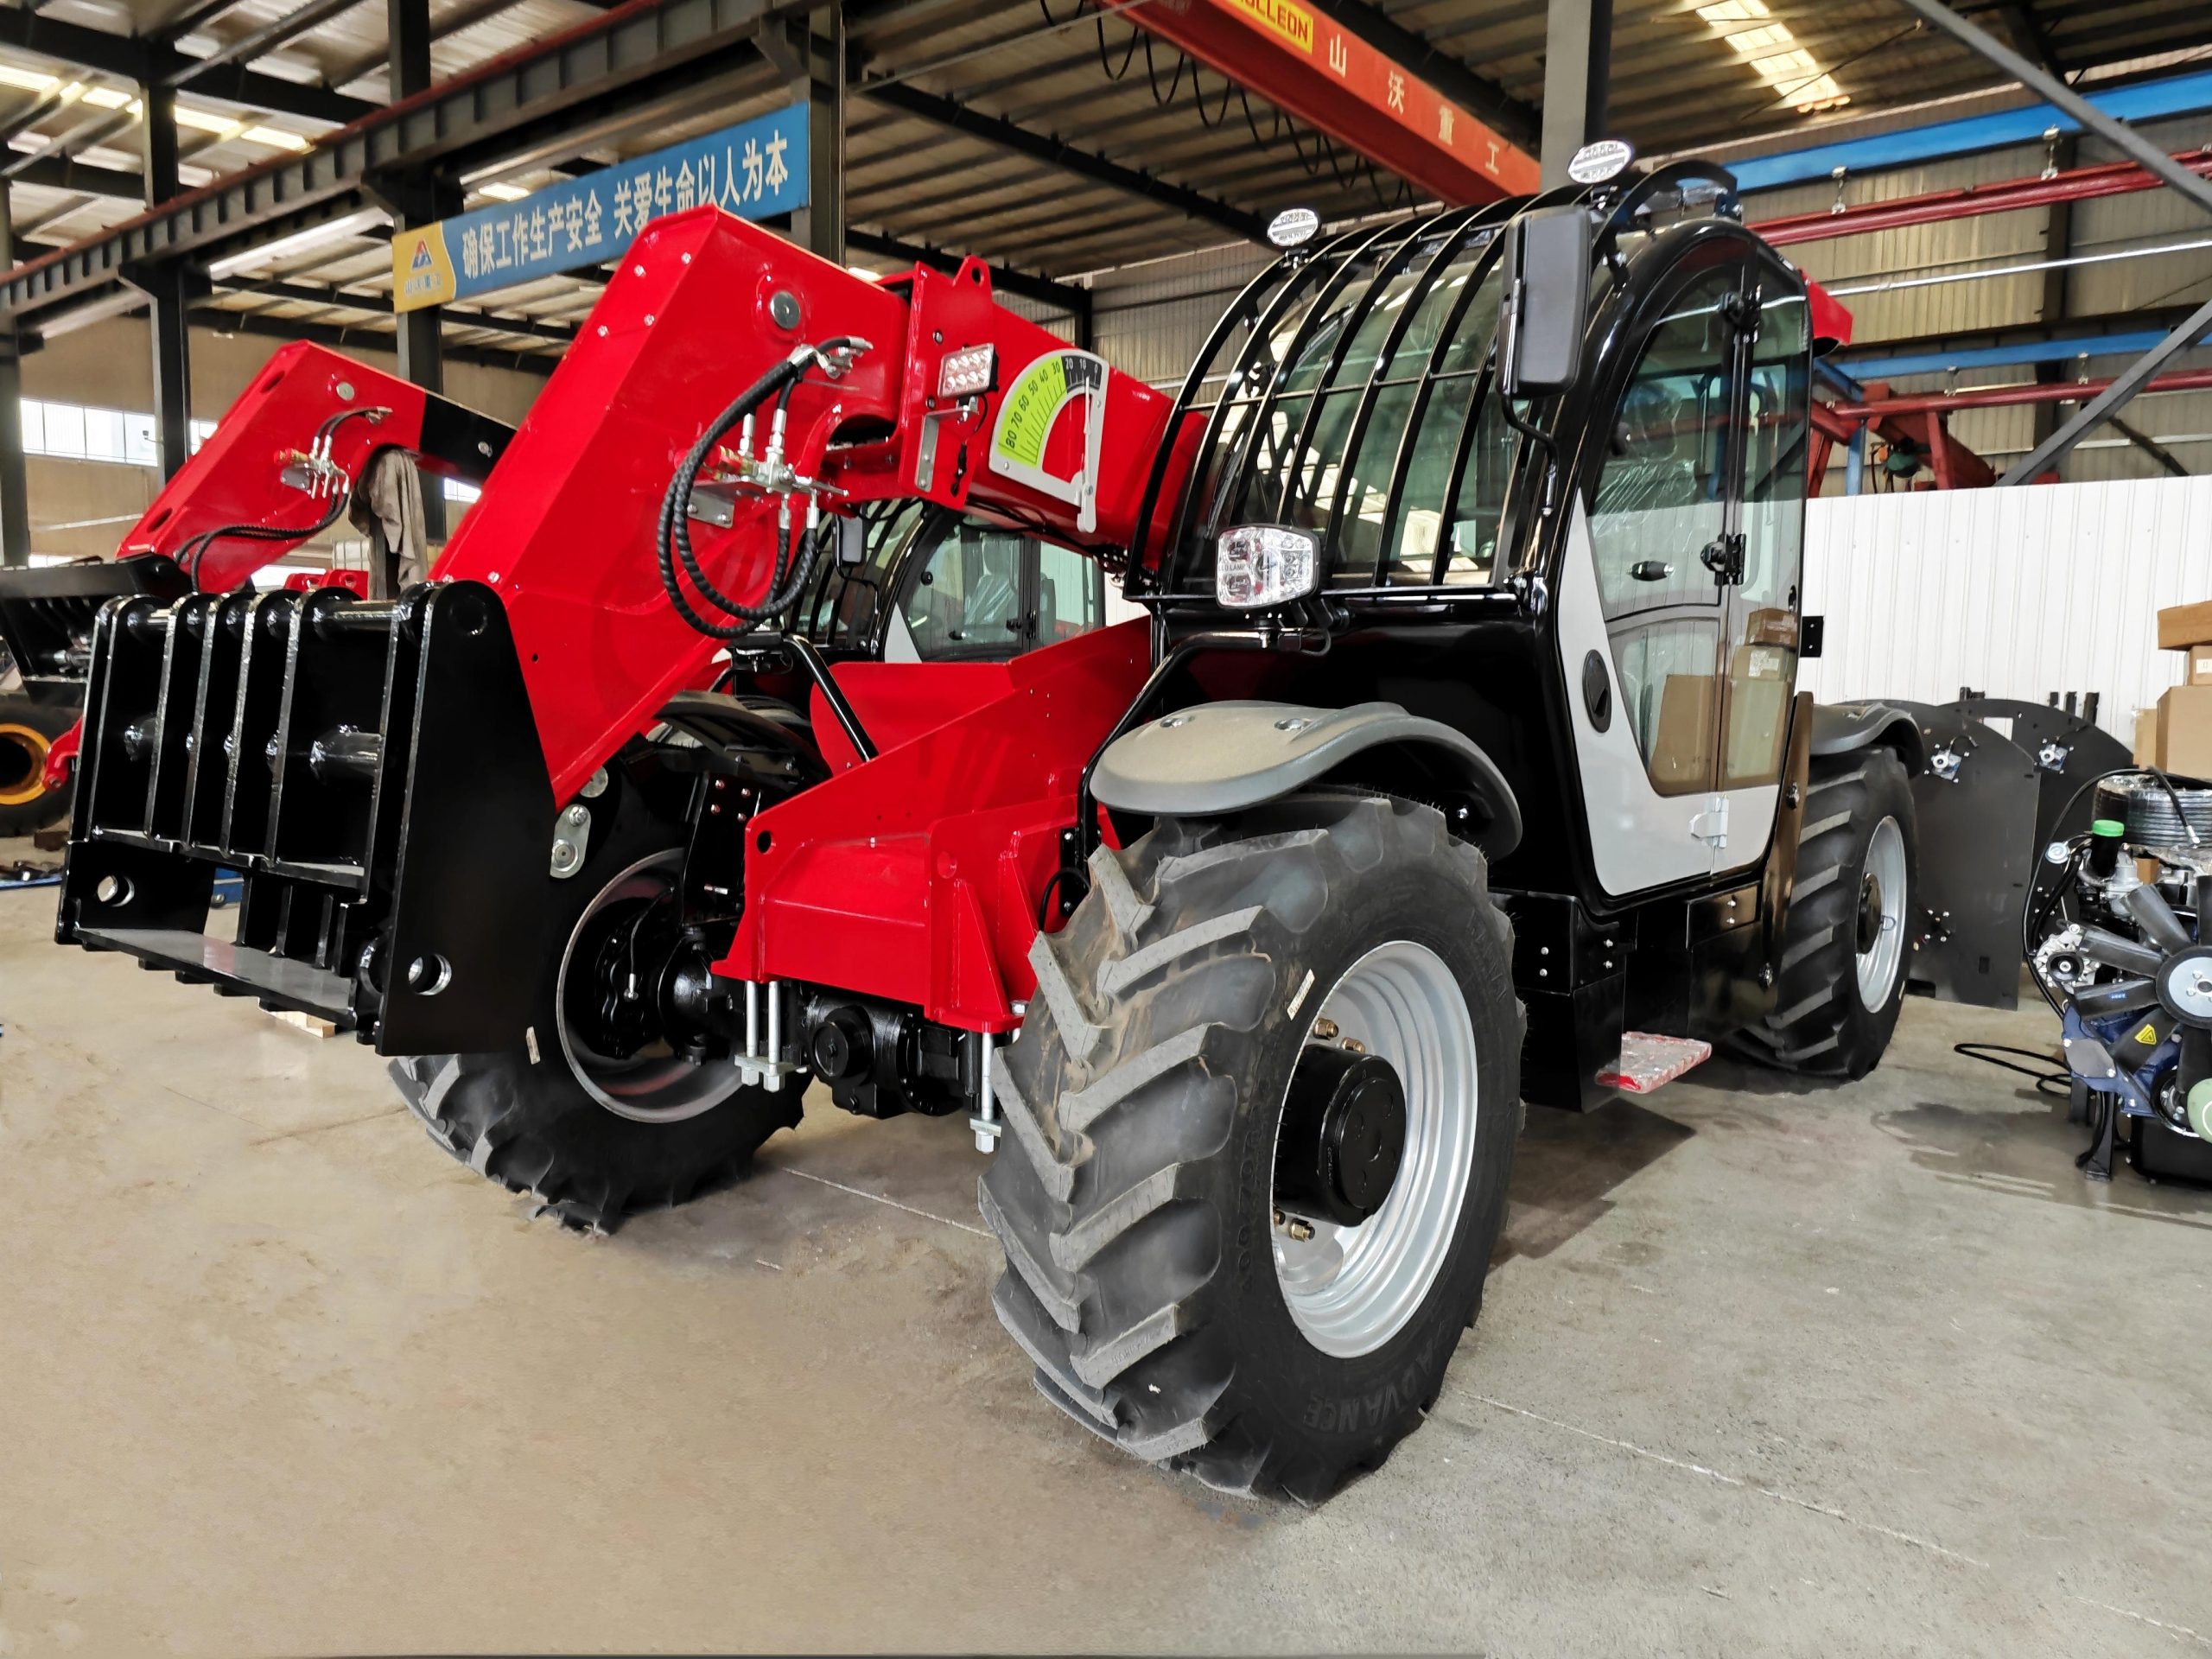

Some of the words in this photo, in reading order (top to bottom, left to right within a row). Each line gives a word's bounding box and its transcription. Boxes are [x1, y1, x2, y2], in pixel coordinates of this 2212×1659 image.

[461, 188, 602, 279] 确保工作生产安全
[614, 130, 788, 239] 关爱生命以人为本
[1005, 430, 1017, 448] 80
[1011, 411, 1022, 429] 70
[1018, 395, 1029, 412] 60
[1028, 380, 1039, 395] 50
[1039, 369, 1049, 384] 40
[1051, 361, 1061, 374] 30
[1065, 358, 1074, 370] 20
[1080, 359, 1087, 370] 10
[1094, 364, 1098, 373] 0
